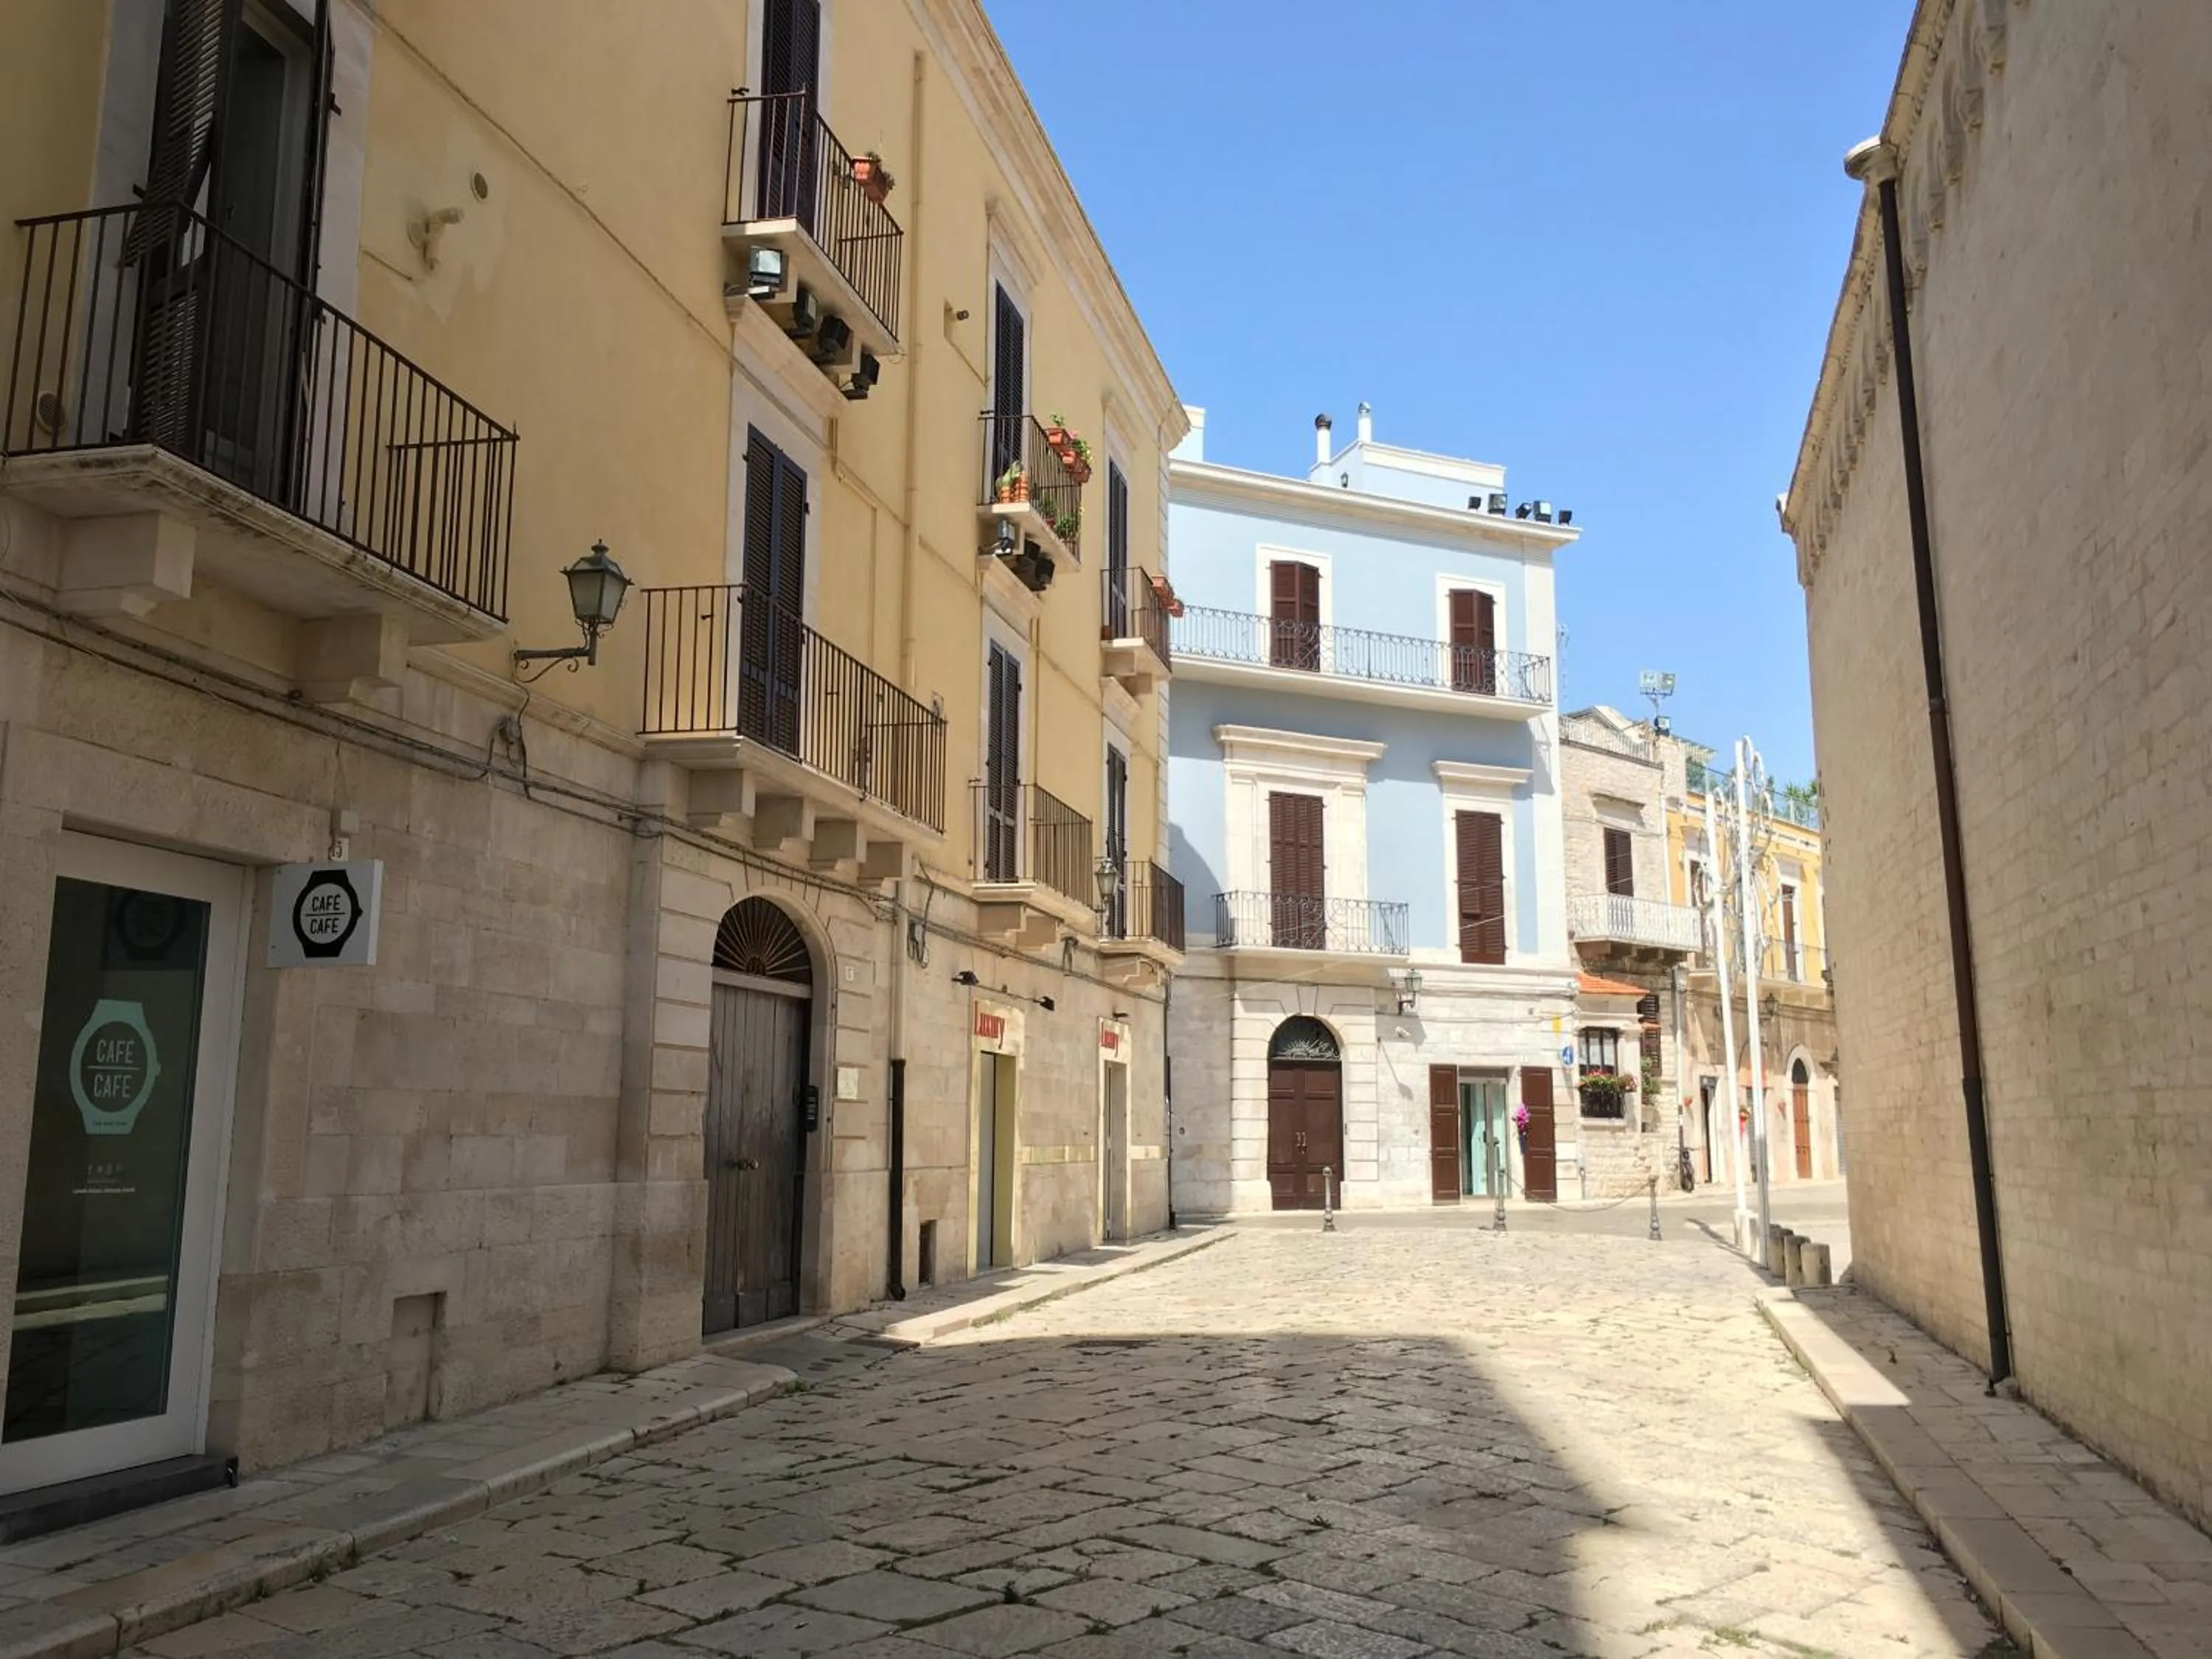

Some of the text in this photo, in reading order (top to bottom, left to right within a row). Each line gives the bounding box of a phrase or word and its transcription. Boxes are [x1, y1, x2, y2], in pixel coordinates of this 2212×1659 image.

[312, 894, 341, 911] CAFE
[310, 918, 339, 934] CAFE
[97, 1038, 135, 1063] CAFE
[94, 1073, 132, 1098] CAFE
